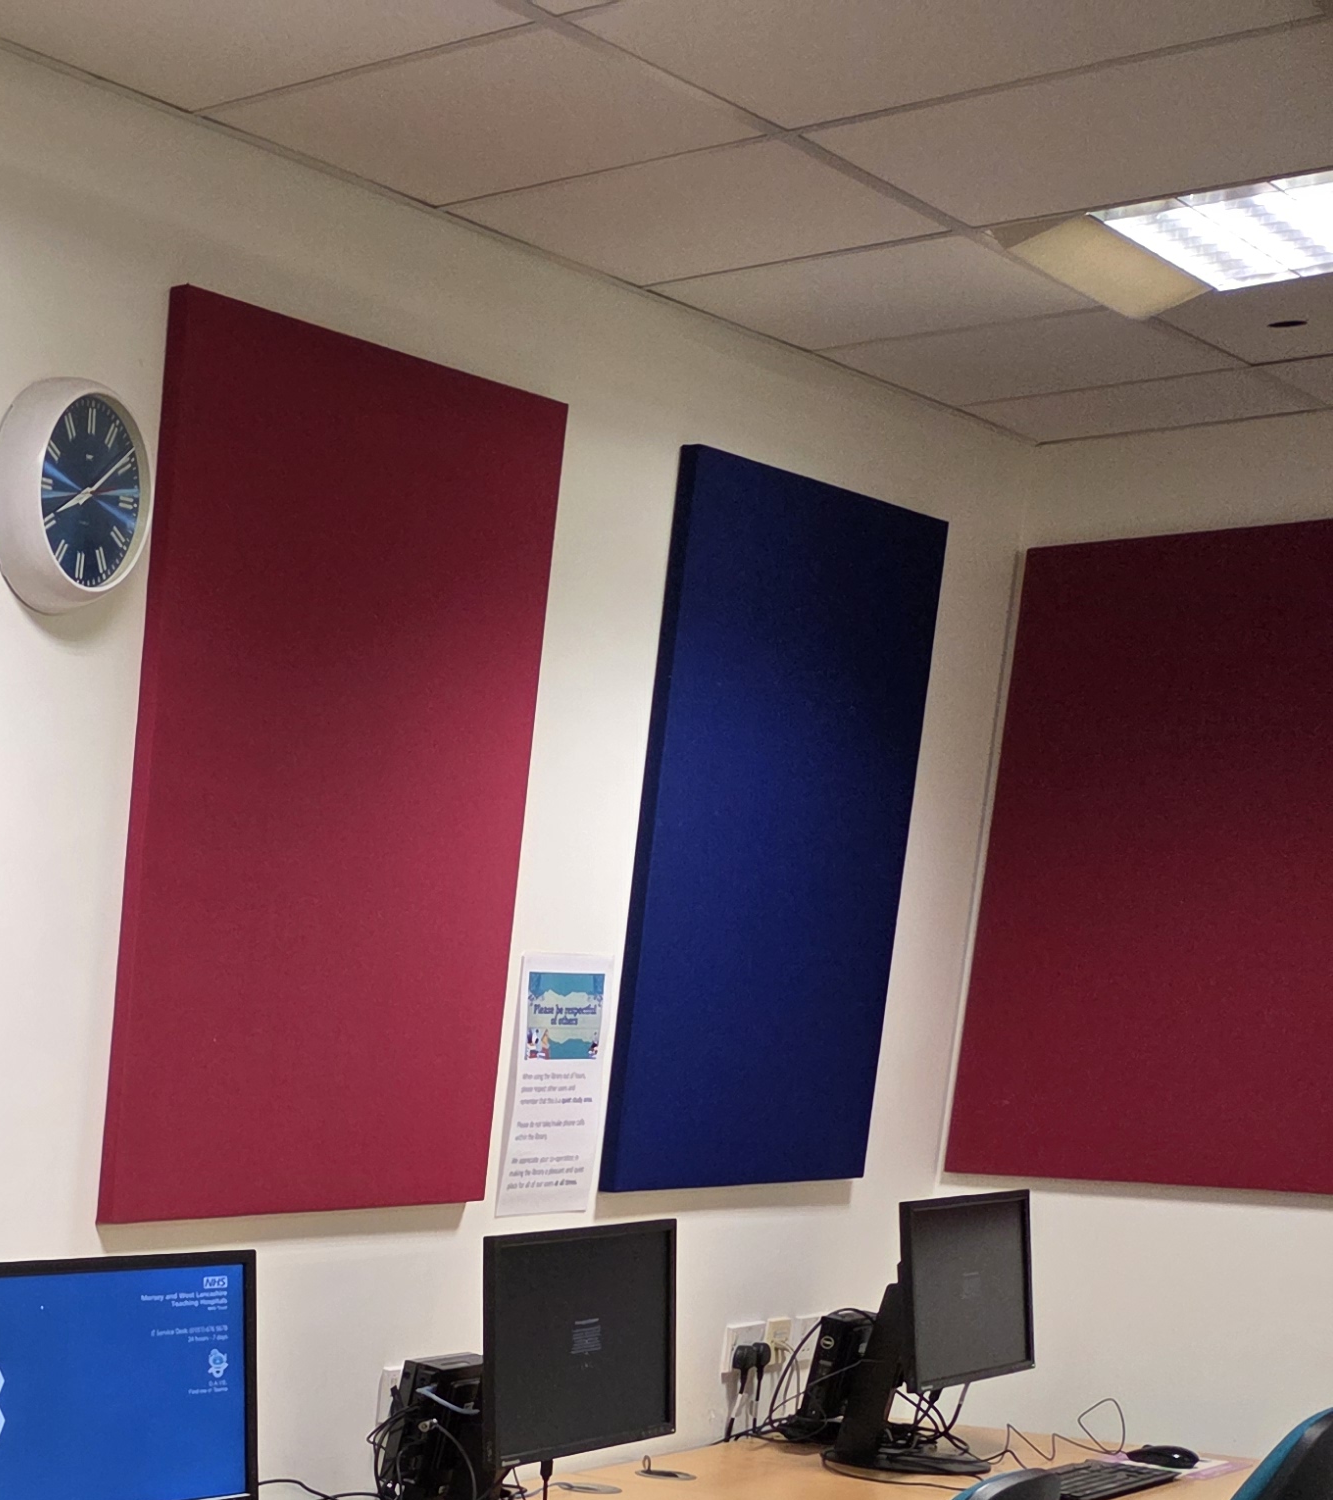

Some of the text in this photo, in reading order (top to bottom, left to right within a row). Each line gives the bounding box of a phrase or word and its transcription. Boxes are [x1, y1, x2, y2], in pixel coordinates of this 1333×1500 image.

[533, 1003, 597, 1017] Please be respectful
[558, 1015, 578, 1025] others
[204, 1276, 227, 1288] NHS
[165, 1292, 177, 1300] and
[196, 1290, 227, 1299] Lancashire
